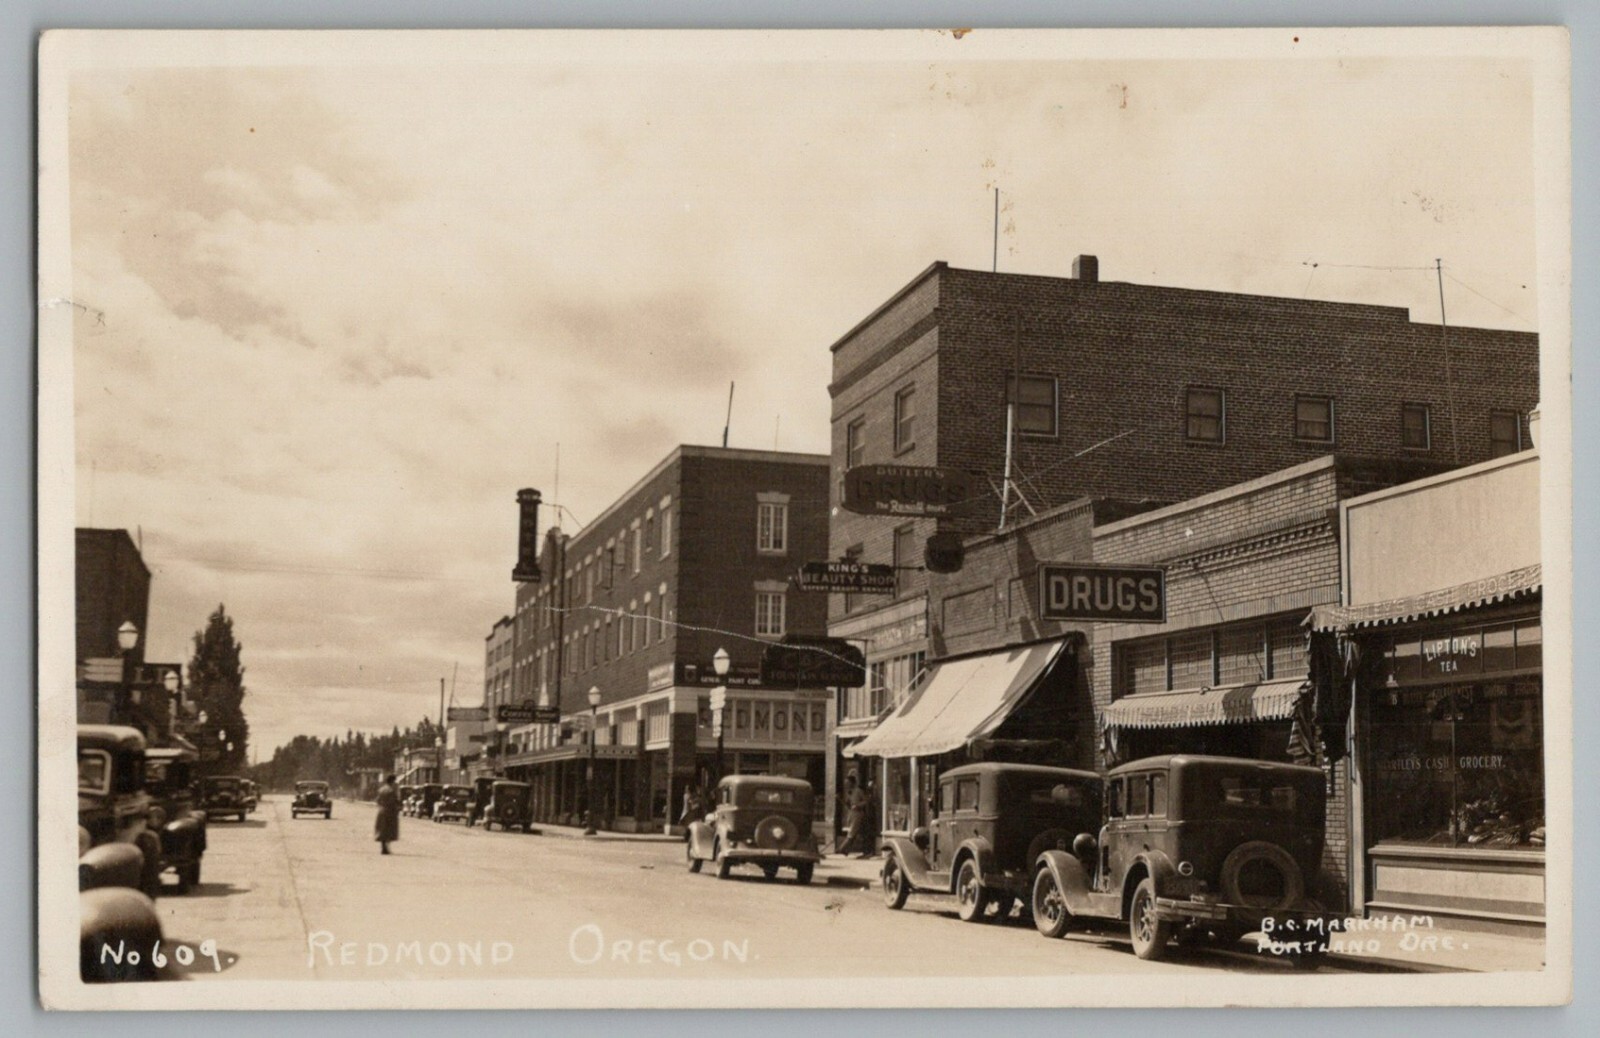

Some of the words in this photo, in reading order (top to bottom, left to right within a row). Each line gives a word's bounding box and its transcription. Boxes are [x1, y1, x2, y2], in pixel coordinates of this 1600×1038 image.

[828, 563, 869, 574] KING'S
[802, 573, 856, 585] BEAUTY
[859, 575, 895, 586] SHOP
[1050, 575, 1158, 612] DRUGS
[1416, 588, 1458, 610] CASH
[1425, 636, 1477, 662] LIPTON'S
[1440, 660, 1458, 673] TEA
[1425, 757, 1449, 769] CASH
